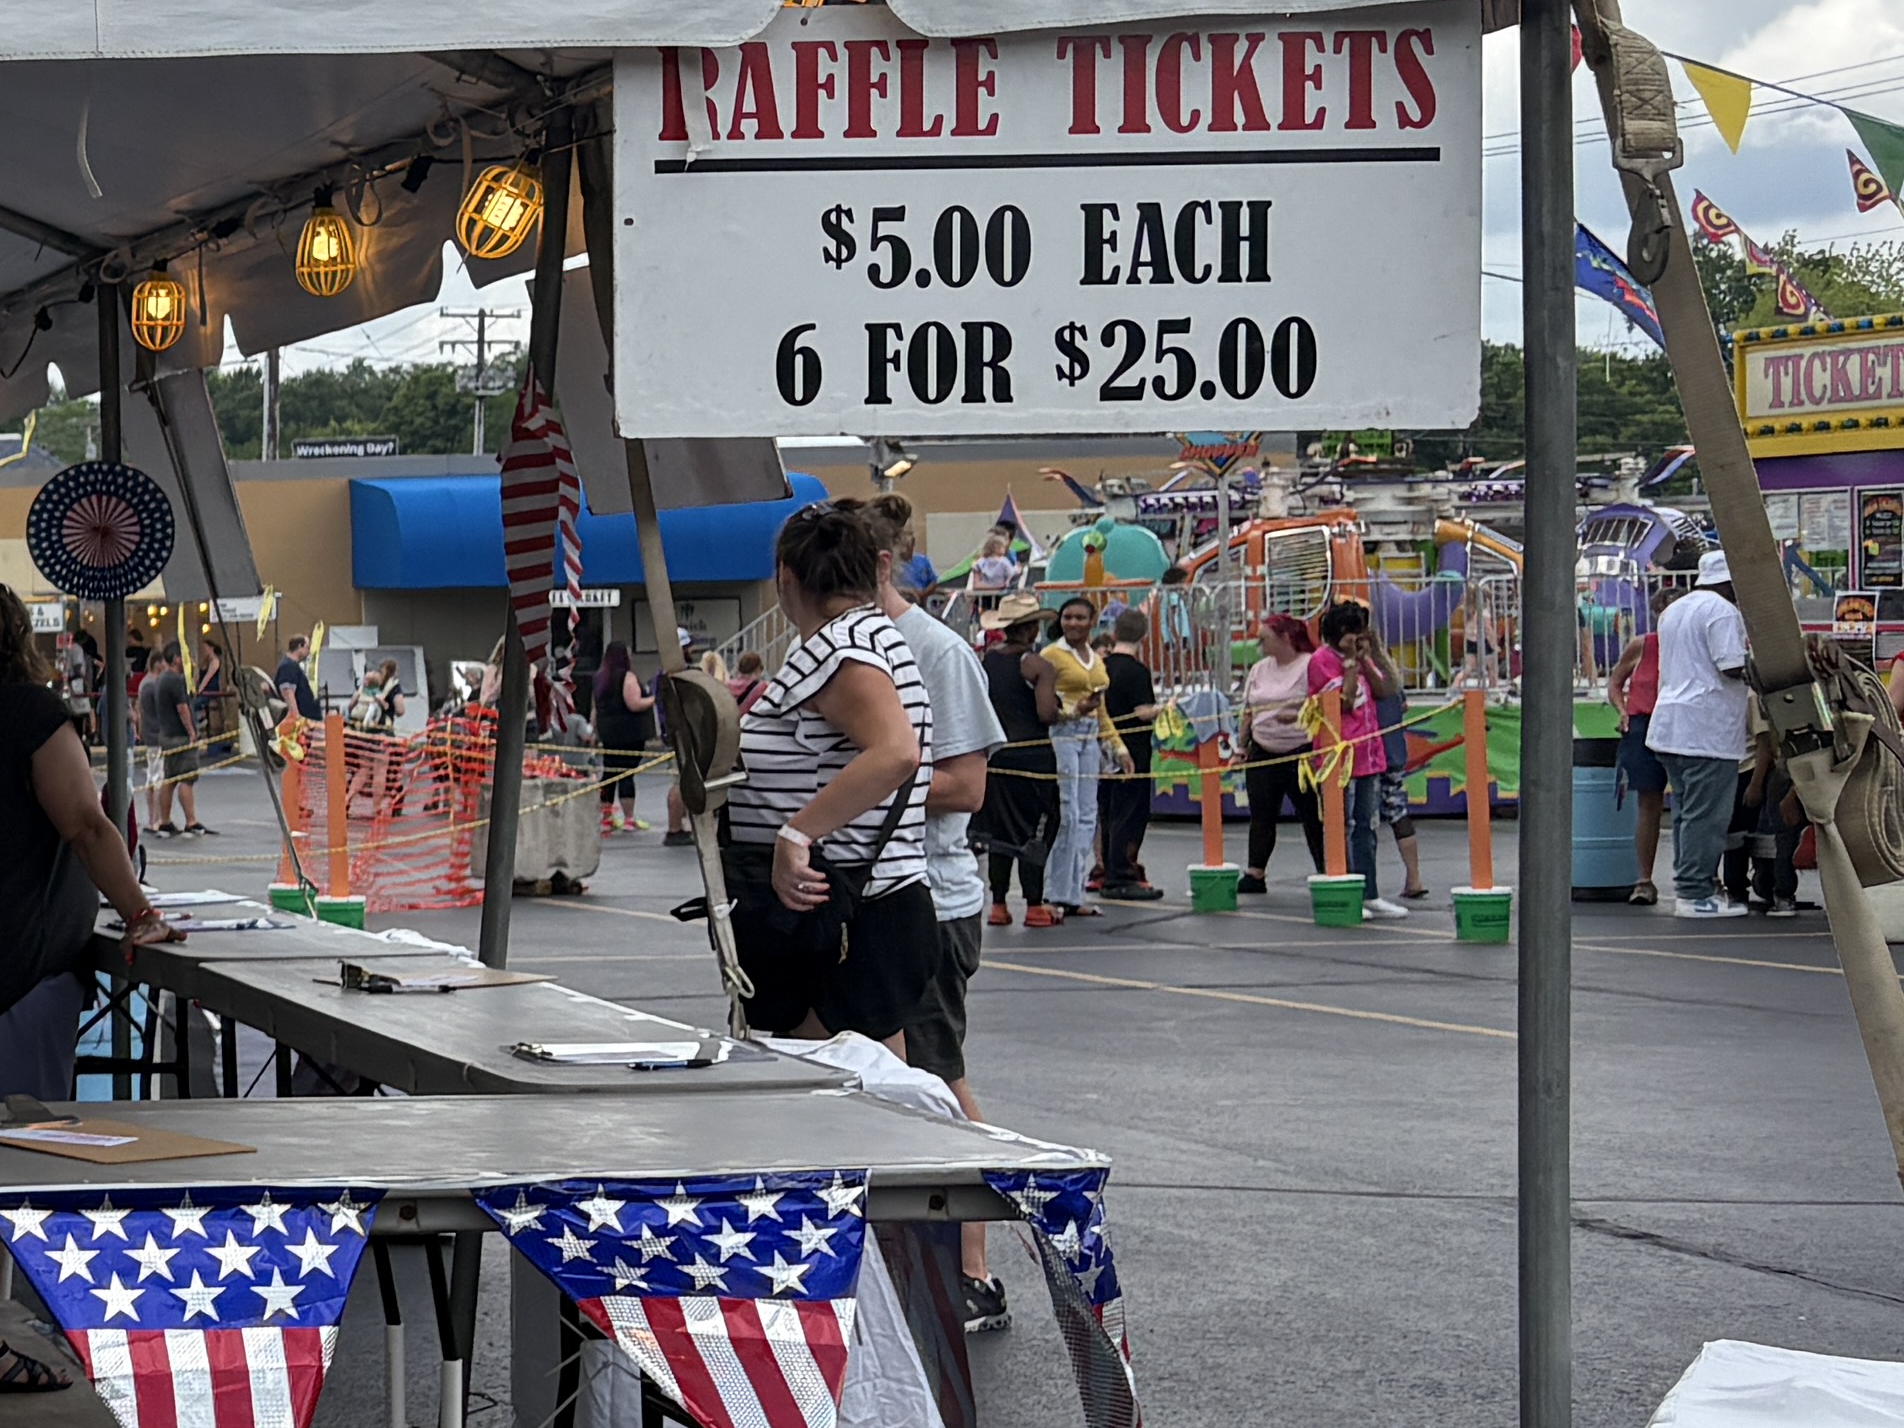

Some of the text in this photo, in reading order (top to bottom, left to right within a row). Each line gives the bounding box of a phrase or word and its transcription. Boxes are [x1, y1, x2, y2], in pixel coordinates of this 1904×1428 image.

[657, 28, 1438, 141] RAFFLE TICKETS
[822, 199, 1273, 289] $5.00 EACH
[776, 315, 1318, 407] 6 FOR $25.00
[1763, 343, 1904, 410] TICKET
